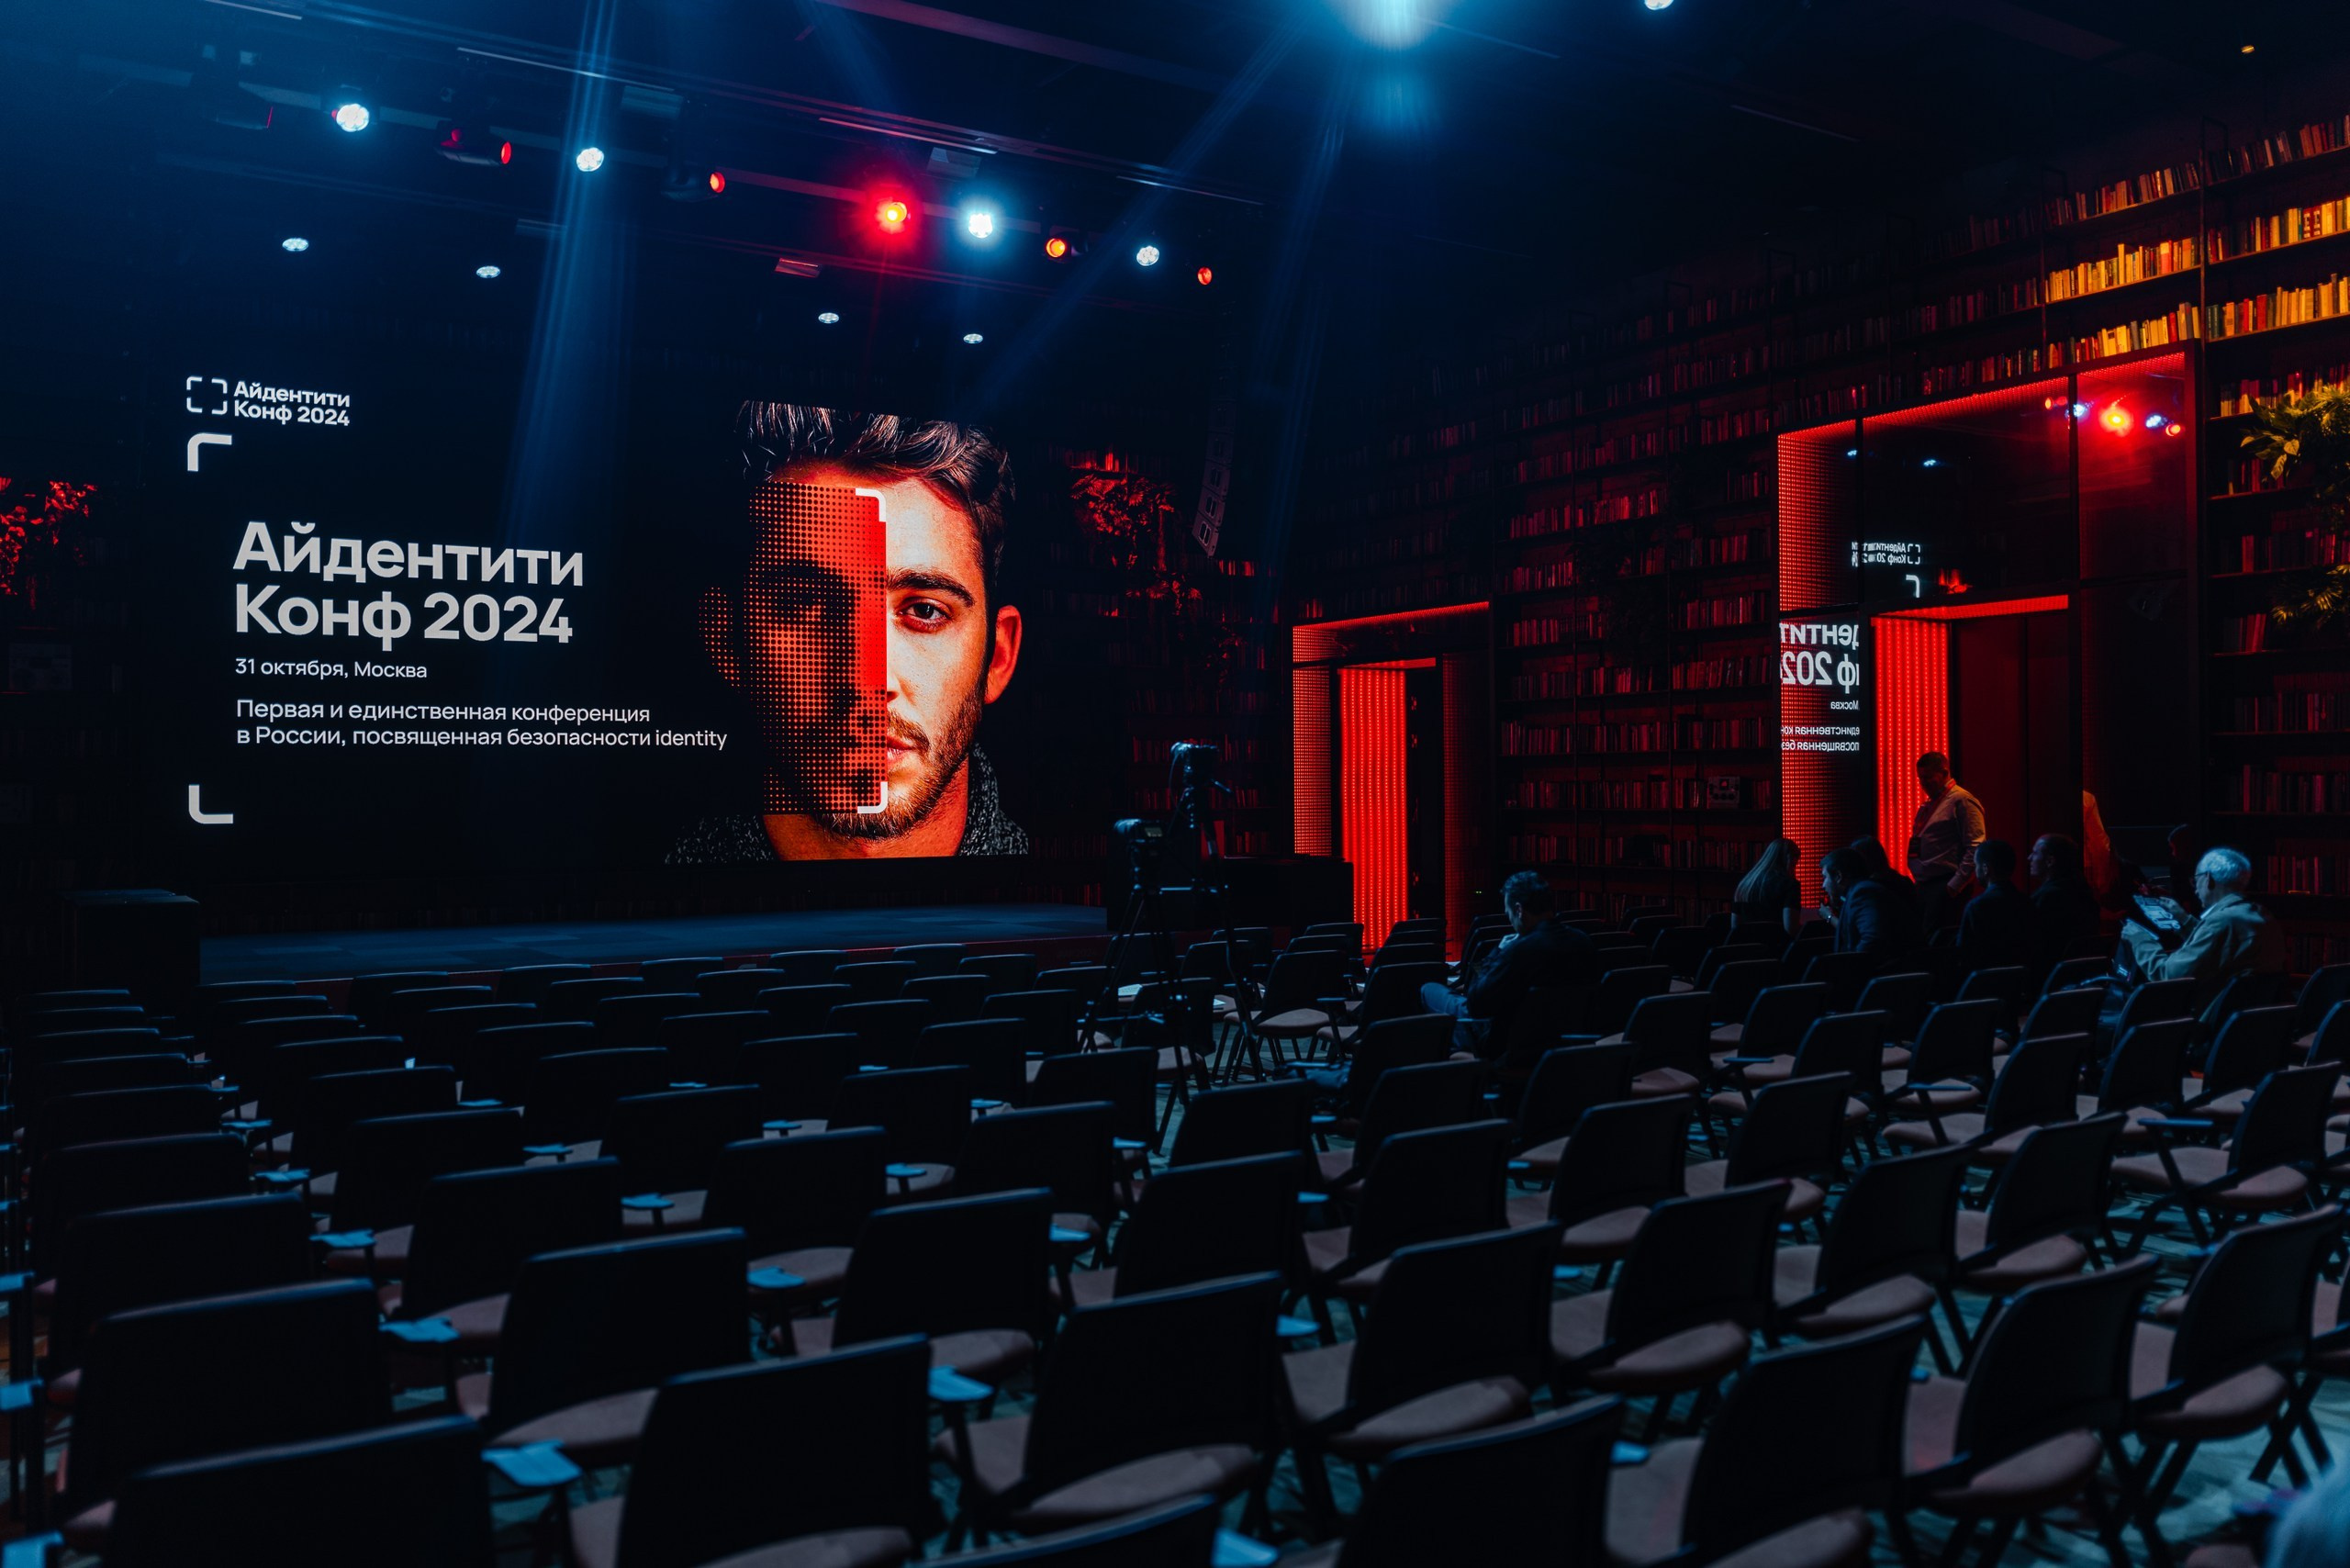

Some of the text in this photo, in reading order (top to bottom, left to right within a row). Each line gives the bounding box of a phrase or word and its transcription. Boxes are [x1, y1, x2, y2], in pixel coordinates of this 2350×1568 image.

[233, 380, 351, 408] Айдентити
[234, 399, 351, 427] Конф 2024
[233, 521, 583, 587] Айдентити
[236, 583, 573, 652] Конф 2024
[235, 657, 428, 680] 31 октября, Москва
[237, 699, 650, 726] Первая и единственная конференция
[237, 725, 728, 751] в России, посвященная безопасности identity
